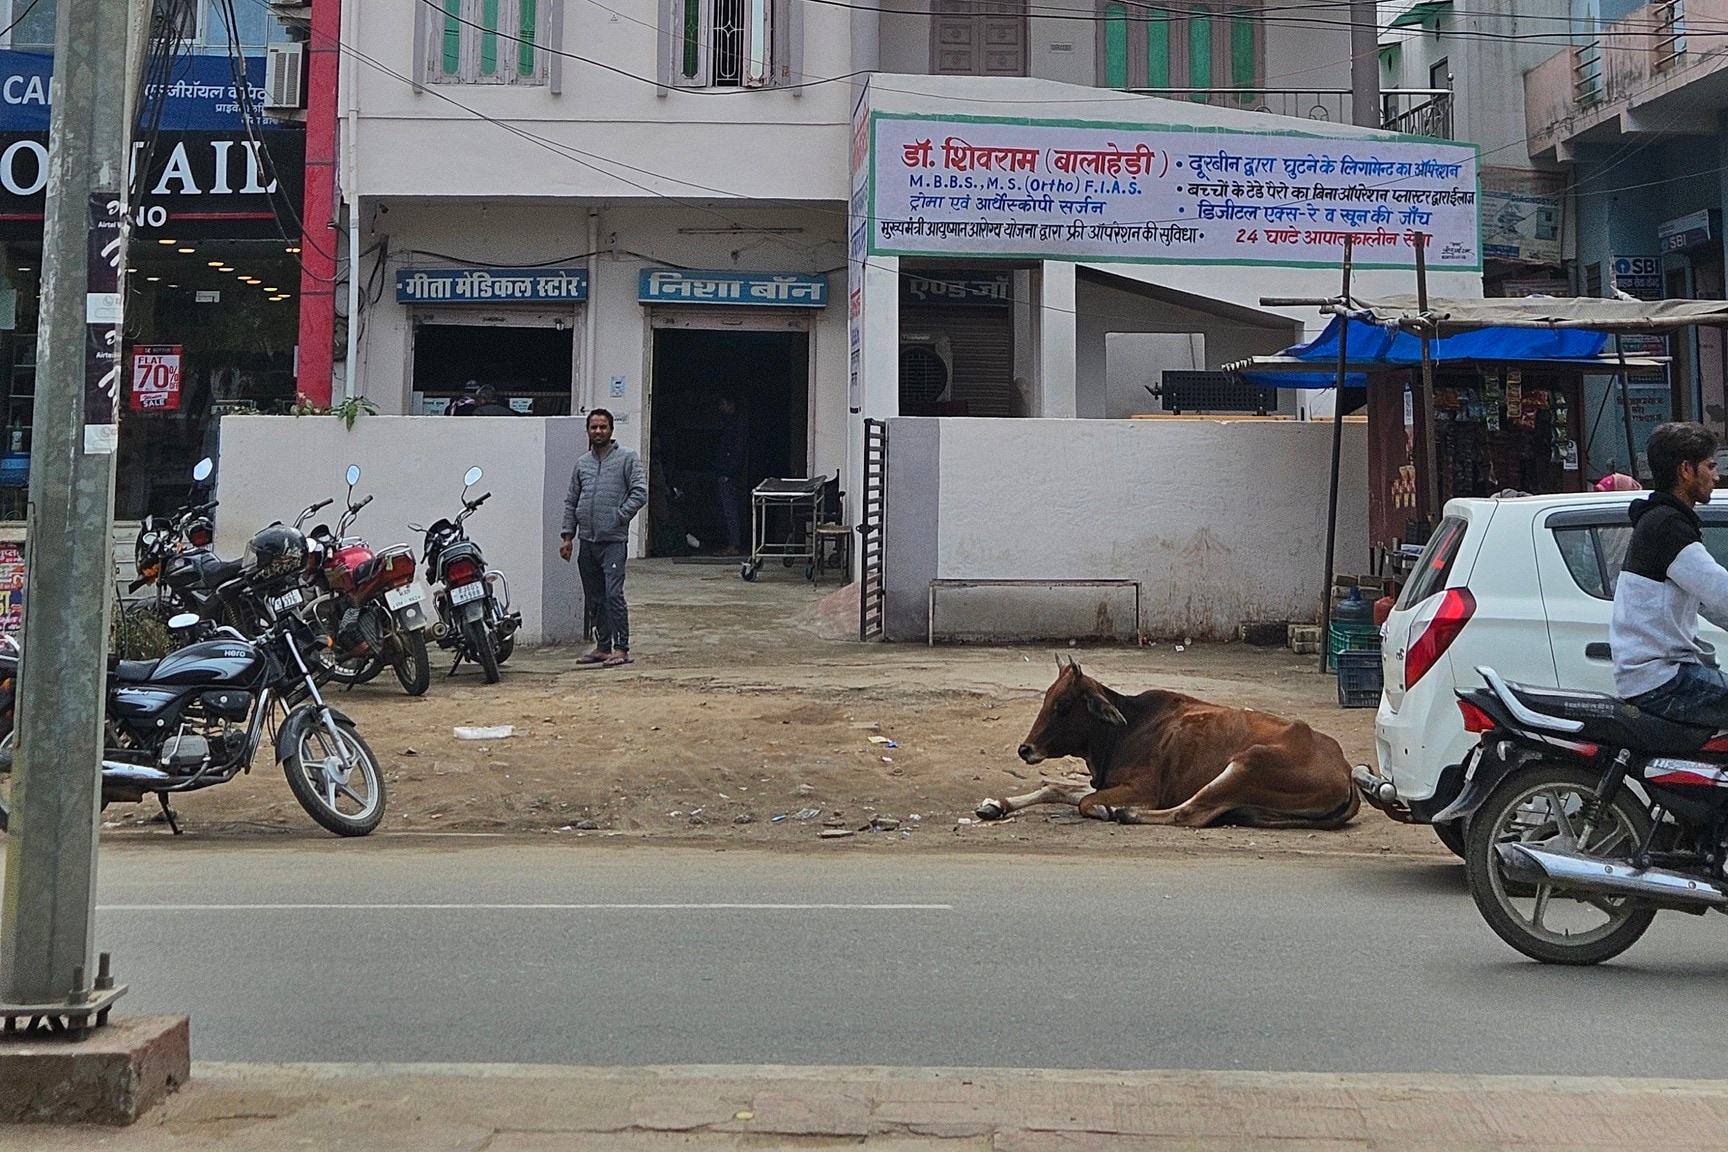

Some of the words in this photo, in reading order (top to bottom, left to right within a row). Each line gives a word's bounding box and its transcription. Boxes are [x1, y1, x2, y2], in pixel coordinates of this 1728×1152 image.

[3, 75, 52, 105] CA
[901, 138, 935, 168] डॉ.
[941, 137, 1040, 173] शिवराम
[1188, 149, 1241, 181] दूरबीन
[1244, 156, 1275, 177] द्वारा
[1396, 161, 1414, 177] का
[949, 193, 971, 211] एवं
[1059, 195, 1107, 214] सर्जन
[1291, 186, 1311, 200] का
[1197, 199, 1260, 222] डिजीटल
[1325, 209, 1336, 223] व
[1339, 207, 1368, 228] खून
[1371, 204, 1391, 224] की
[880, 217, 926, 239] मुख्यमंत्री
[1004, 218, 1038, 239] योजना
[1039, 224, 1062, 242] द्वारा
[1066, 219, 1084, 243] फ्री
[1088, 220, 1141, 243] ऑपरेशन
[1142, 222, 1158, 242] की
[1158, 225, 1199, 245] सुविधा
[1236, 229, 1258, 244] 24
[1263, 225, 1300, 245] घण्टे
[1669, 234, 1687, 249] SBI
[1632, 259, 1659, 274] SBI
[406, 271, 452, 298] गीता
[456, 272, 533, 298] मेडिकल
[537, 271, 579, 298] स्टोर
[649, 272, 743, 299] निशा
[750, 275, 825, 300] बॉन
[143, 399, 164, 408] SALE
[224, 649, 246, 657] Hero
